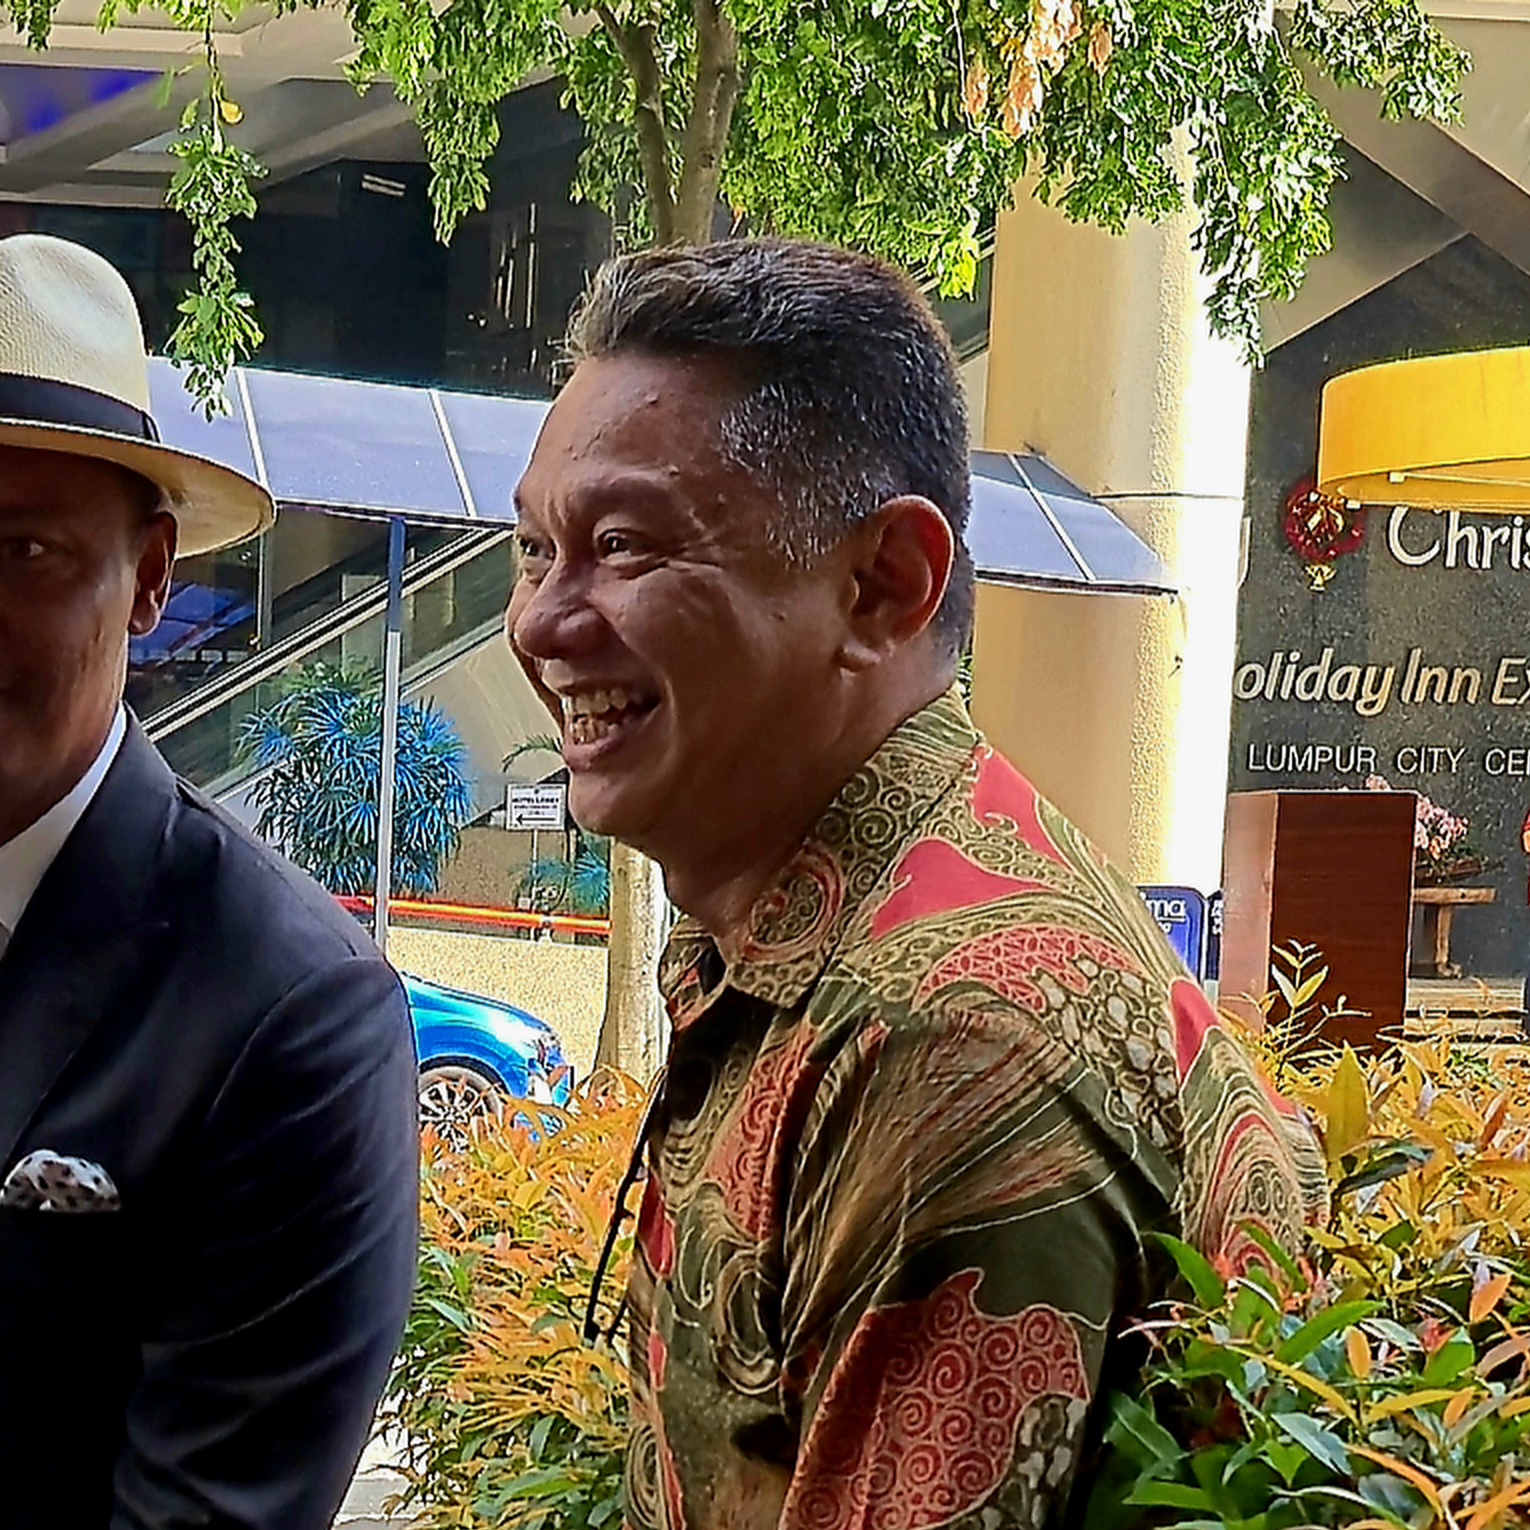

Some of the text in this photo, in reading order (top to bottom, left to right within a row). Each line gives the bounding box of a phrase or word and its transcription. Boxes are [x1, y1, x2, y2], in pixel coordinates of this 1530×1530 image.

[1235, 648, 1395, 716] oliday
[1402, 648, 1483, 703] Inn
[1248, 743, 1376, 773] LUMPUR
[1396, 746, 1466, 775] CITY
